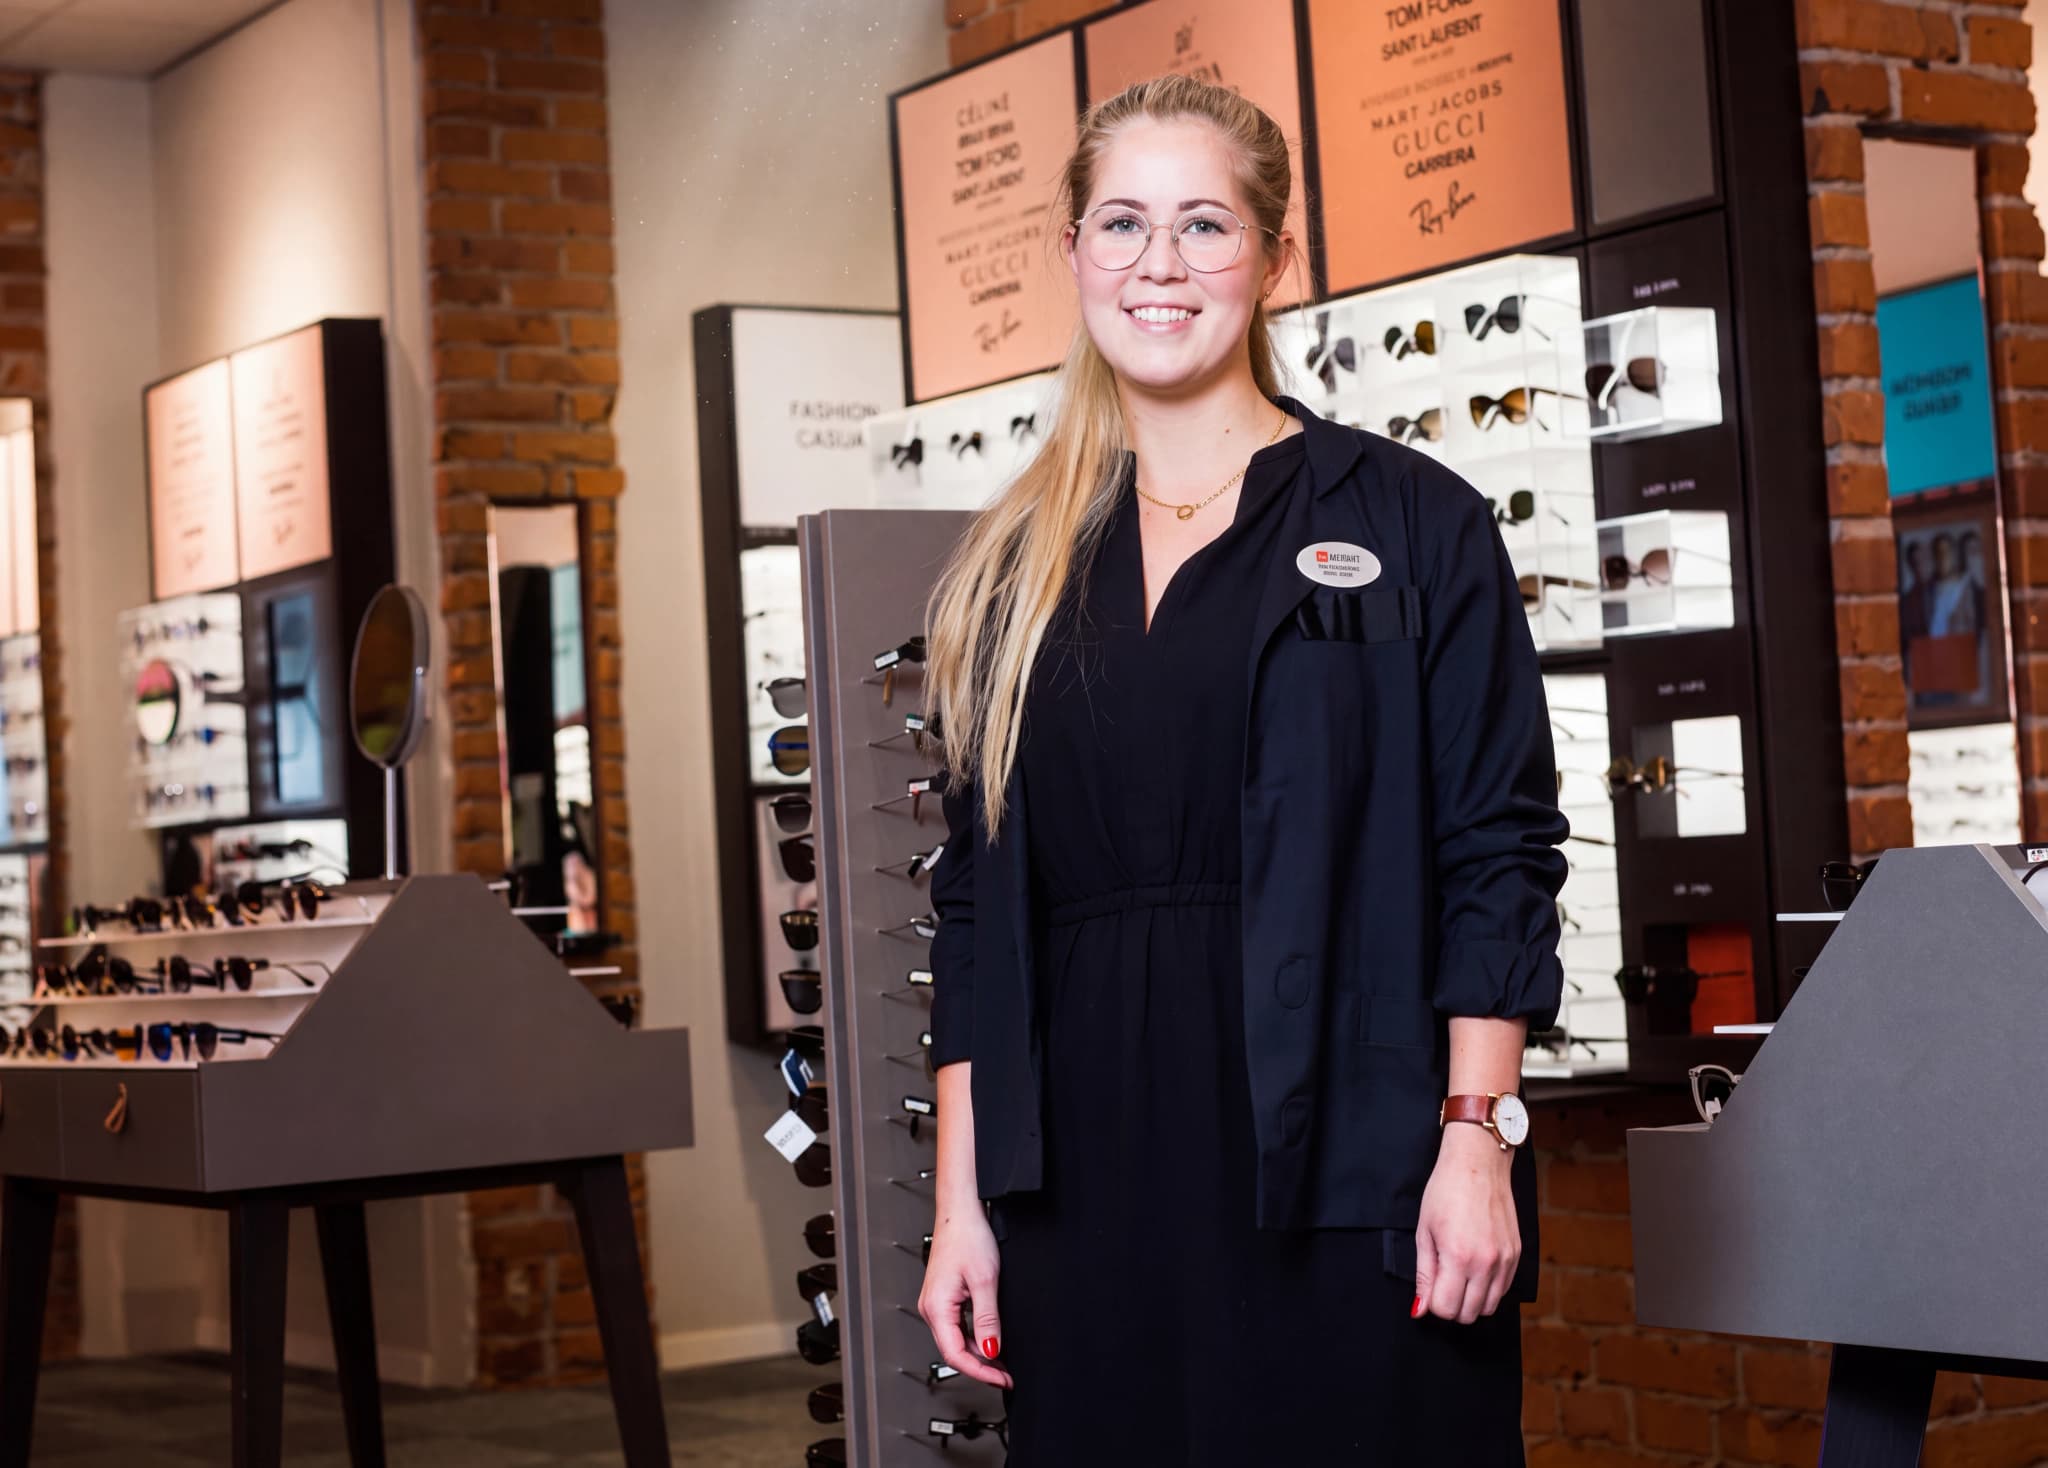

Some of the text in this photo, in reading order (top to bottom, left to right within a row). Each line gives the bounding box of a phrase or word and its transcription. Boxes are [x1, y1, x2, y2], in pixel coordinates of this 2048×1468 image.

[1385, 1, 1423, 31] TOM
[1419, 12, 1482, 49] LAURENT
[1427, 79, 1503, 117] JACOBS
[1392, 110, 1486, 158] GUCCI
[1404, 144, 1477, 179] CARRERA
[959, 250, 1029, 289] GUCCI
[796, 429, 866, 449] CASUA
